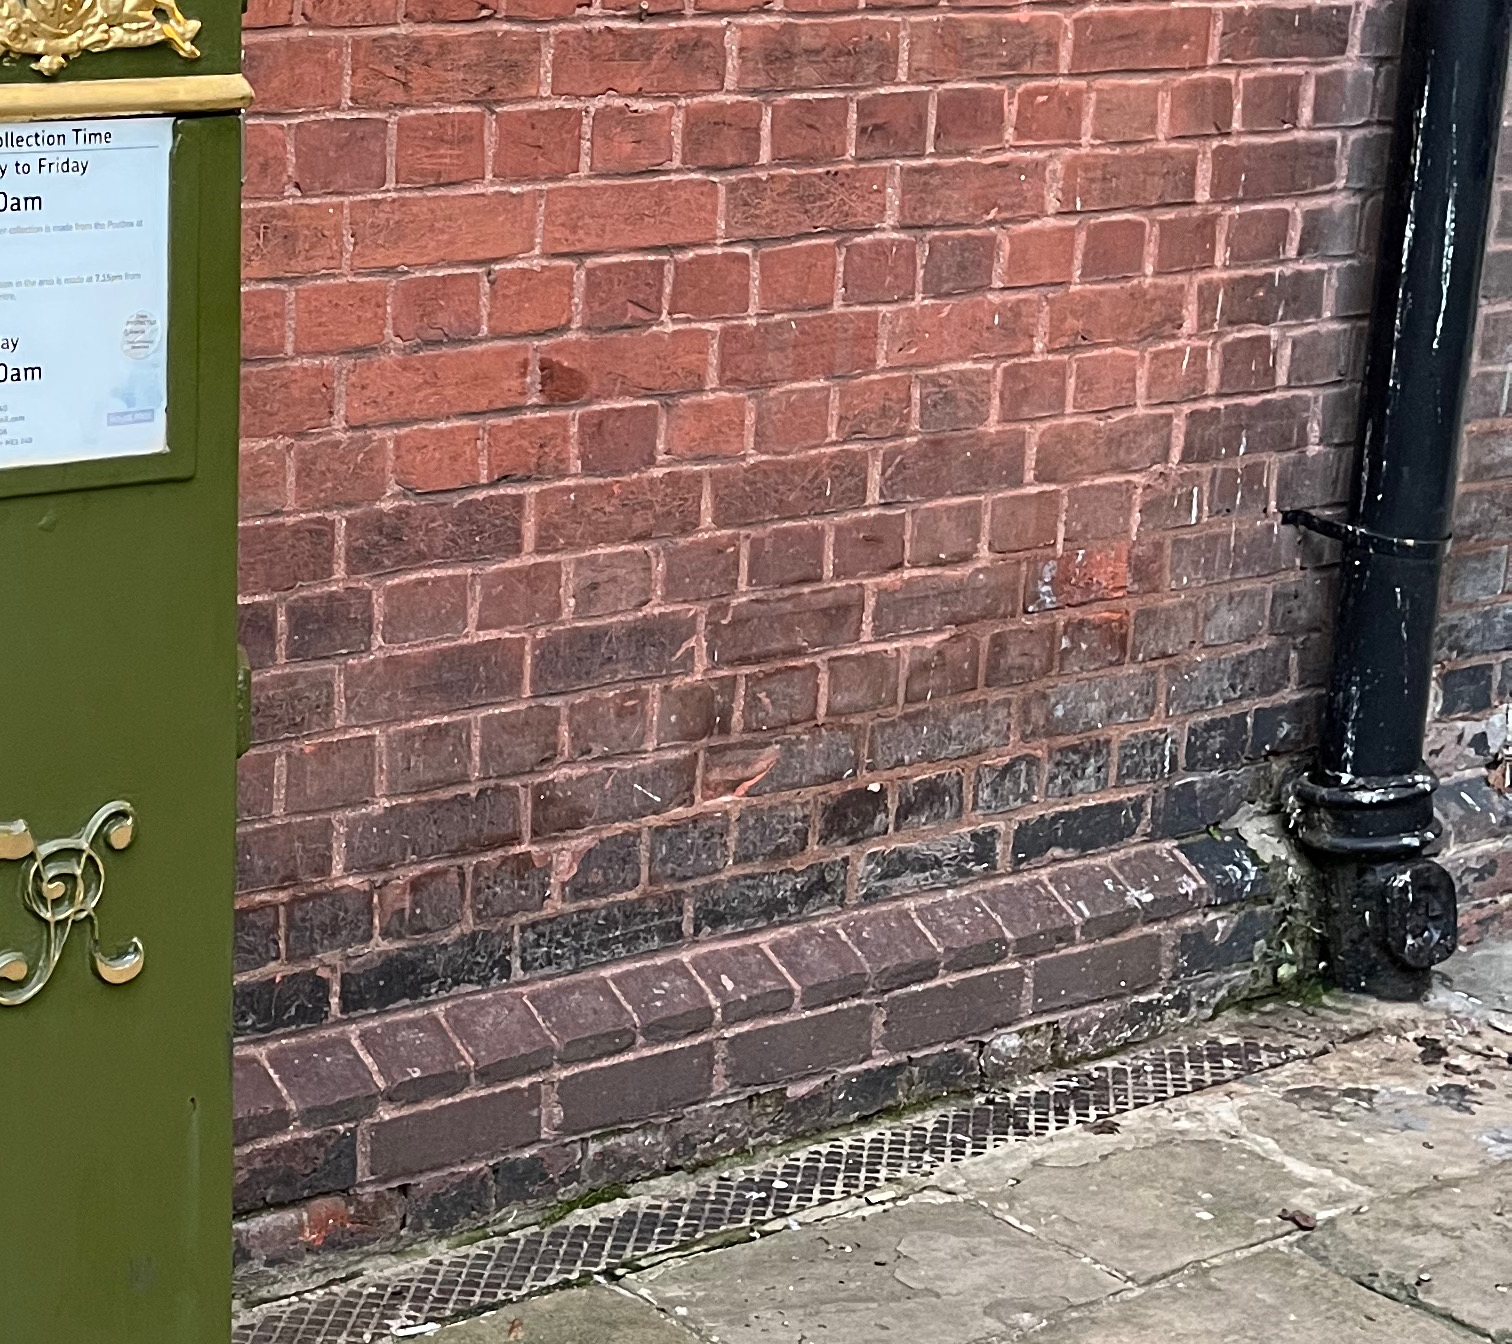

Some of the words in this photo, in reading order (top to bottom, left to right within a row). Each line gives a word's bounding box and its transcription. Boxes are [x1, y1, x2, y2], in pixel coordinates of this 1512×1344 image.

[72, 127, 112, 145] Time
[15, 160, 31, 175] to
[38, 156, 89, 177] Friday
